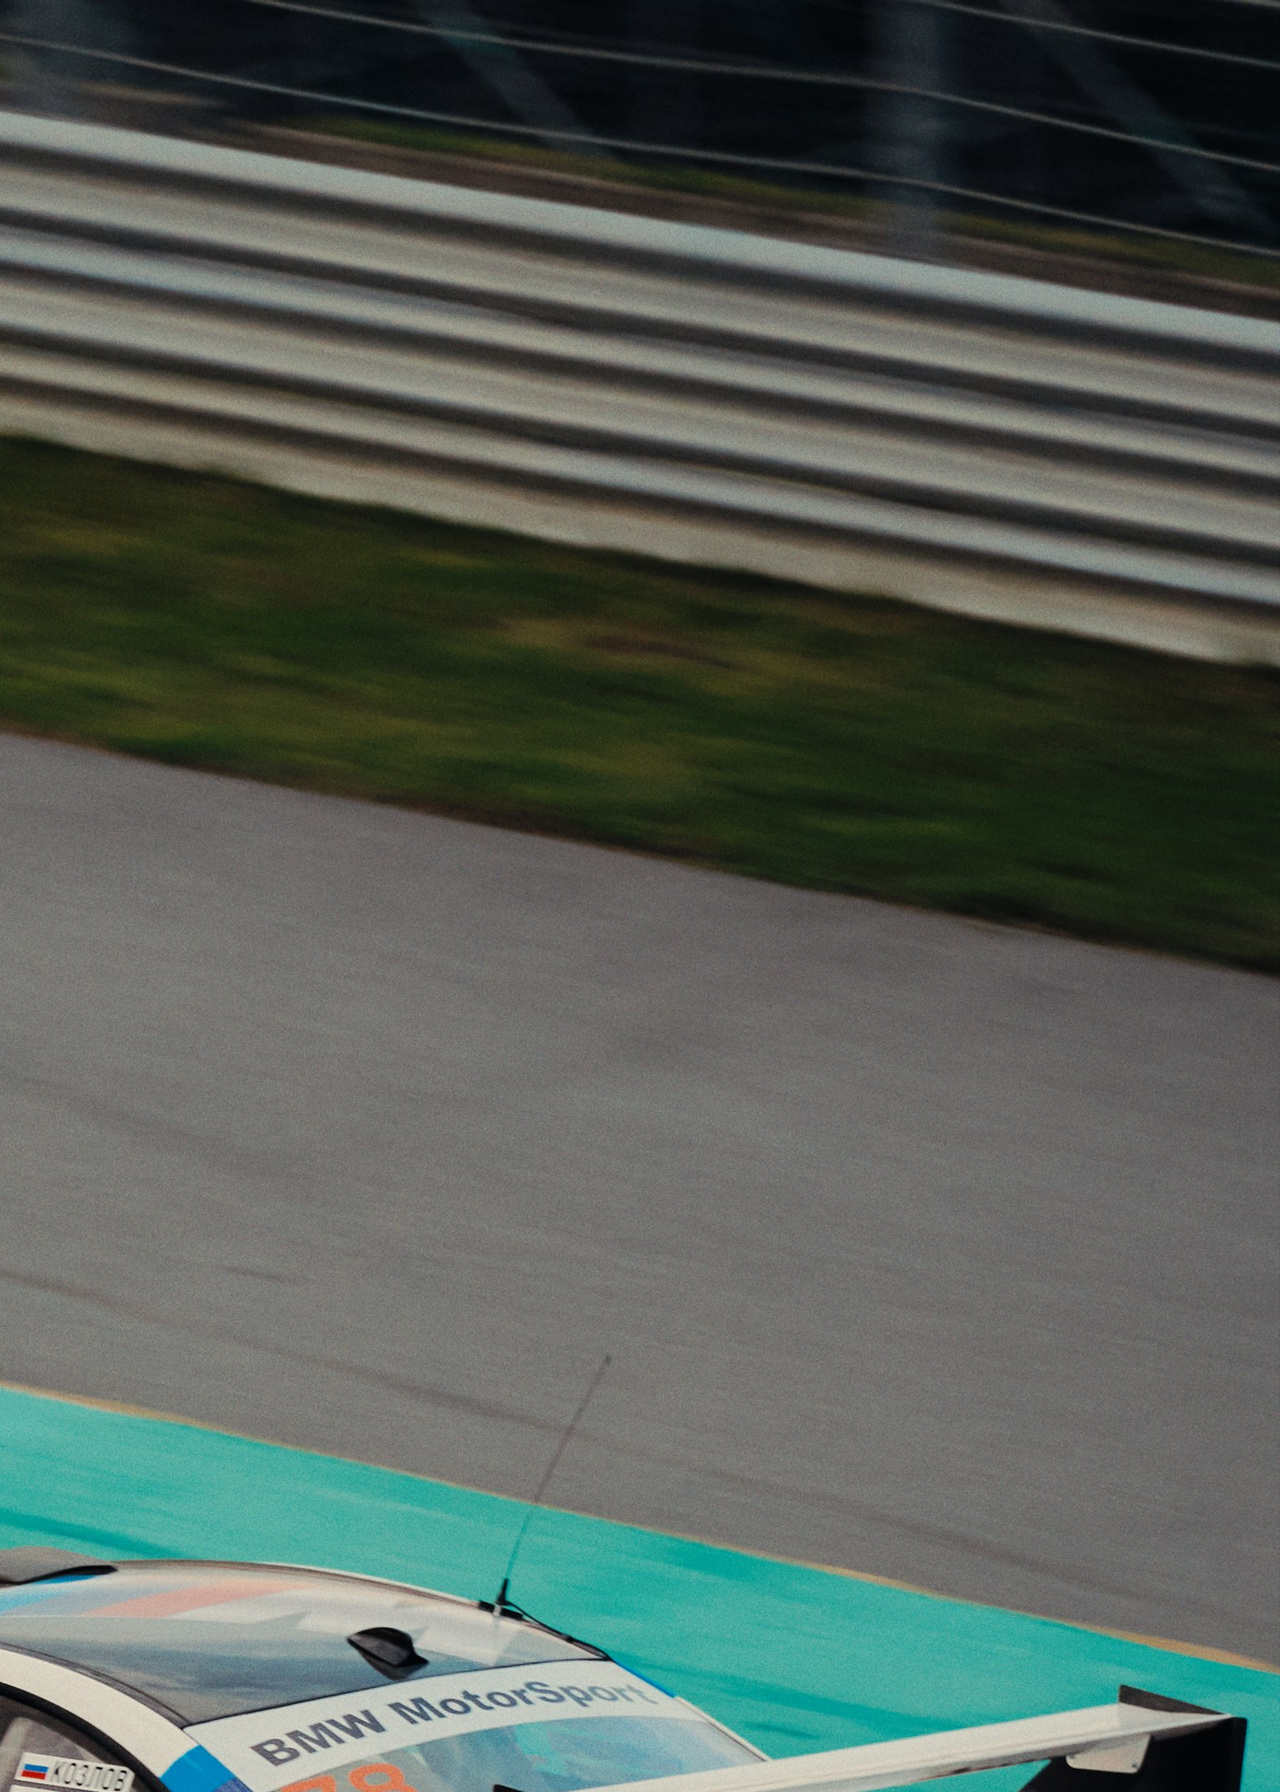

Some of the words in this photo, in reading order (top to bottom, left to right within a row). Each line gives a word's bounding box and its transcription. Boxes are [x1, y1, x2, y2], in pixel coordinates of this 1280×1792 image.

[250, 1708, 387, 1767] BMW
[390, 1681, 658, 1726] MotorSport
[51, 1760, 129, 1792] КОЗЛОВ
